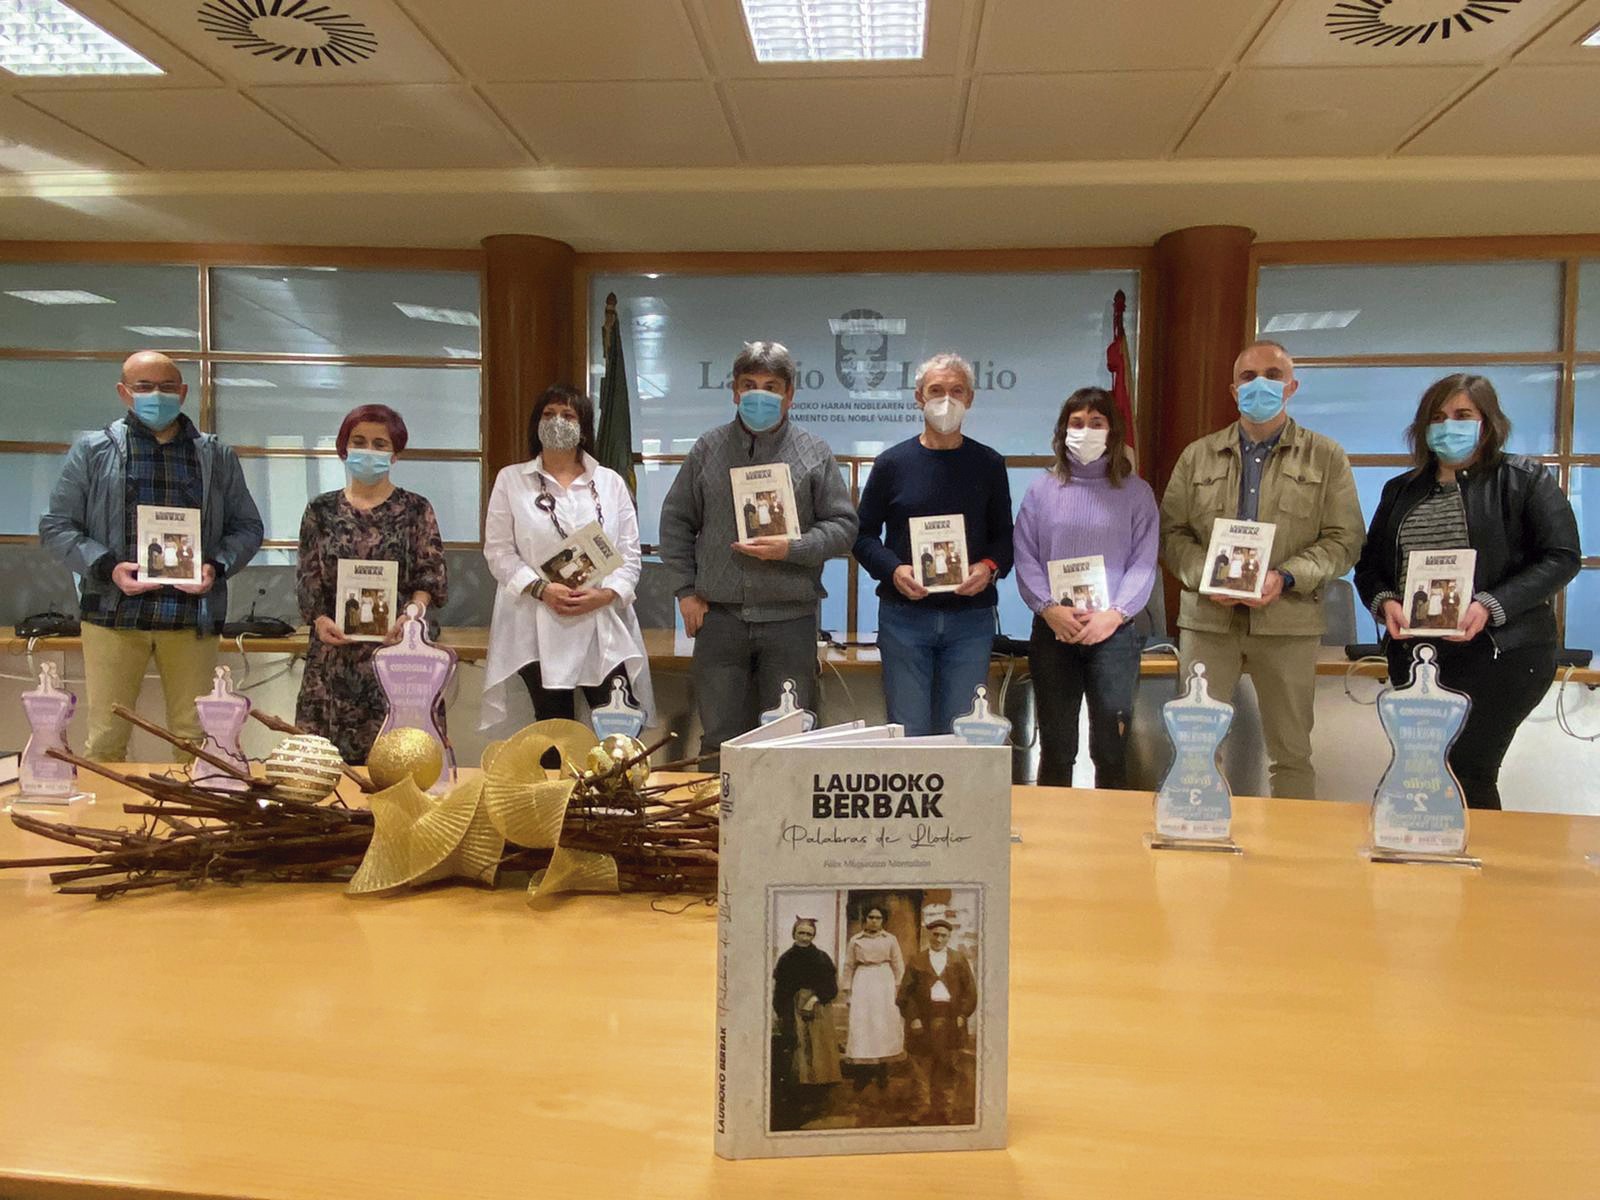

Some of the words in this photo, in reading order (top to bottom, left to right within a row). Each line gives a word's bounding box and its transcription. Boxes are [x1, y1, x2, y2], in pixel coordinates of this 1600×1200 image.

[821, 401, 852, 411] HARAN
[854, 402, 905, 411] NOBLEAREN
[830, 413, 846, 422] DEL
[847, 413, 876, 423] NOBLE
[877, 414, 904, 423] VALLE
[905, 414, 918, 423] DE
[813, 773, 945, 793] LAUDIOKO
[812, 793, 944, 819] BERBAK
[782, 824, 867, 851] Palabras
[876, 827, 901, 849] de
[910, 823, 972, 849] Llodio
[717, 1026, 728, 1071] BERBAK
[716, 1072, 728, 1134] LAUDIOKO
